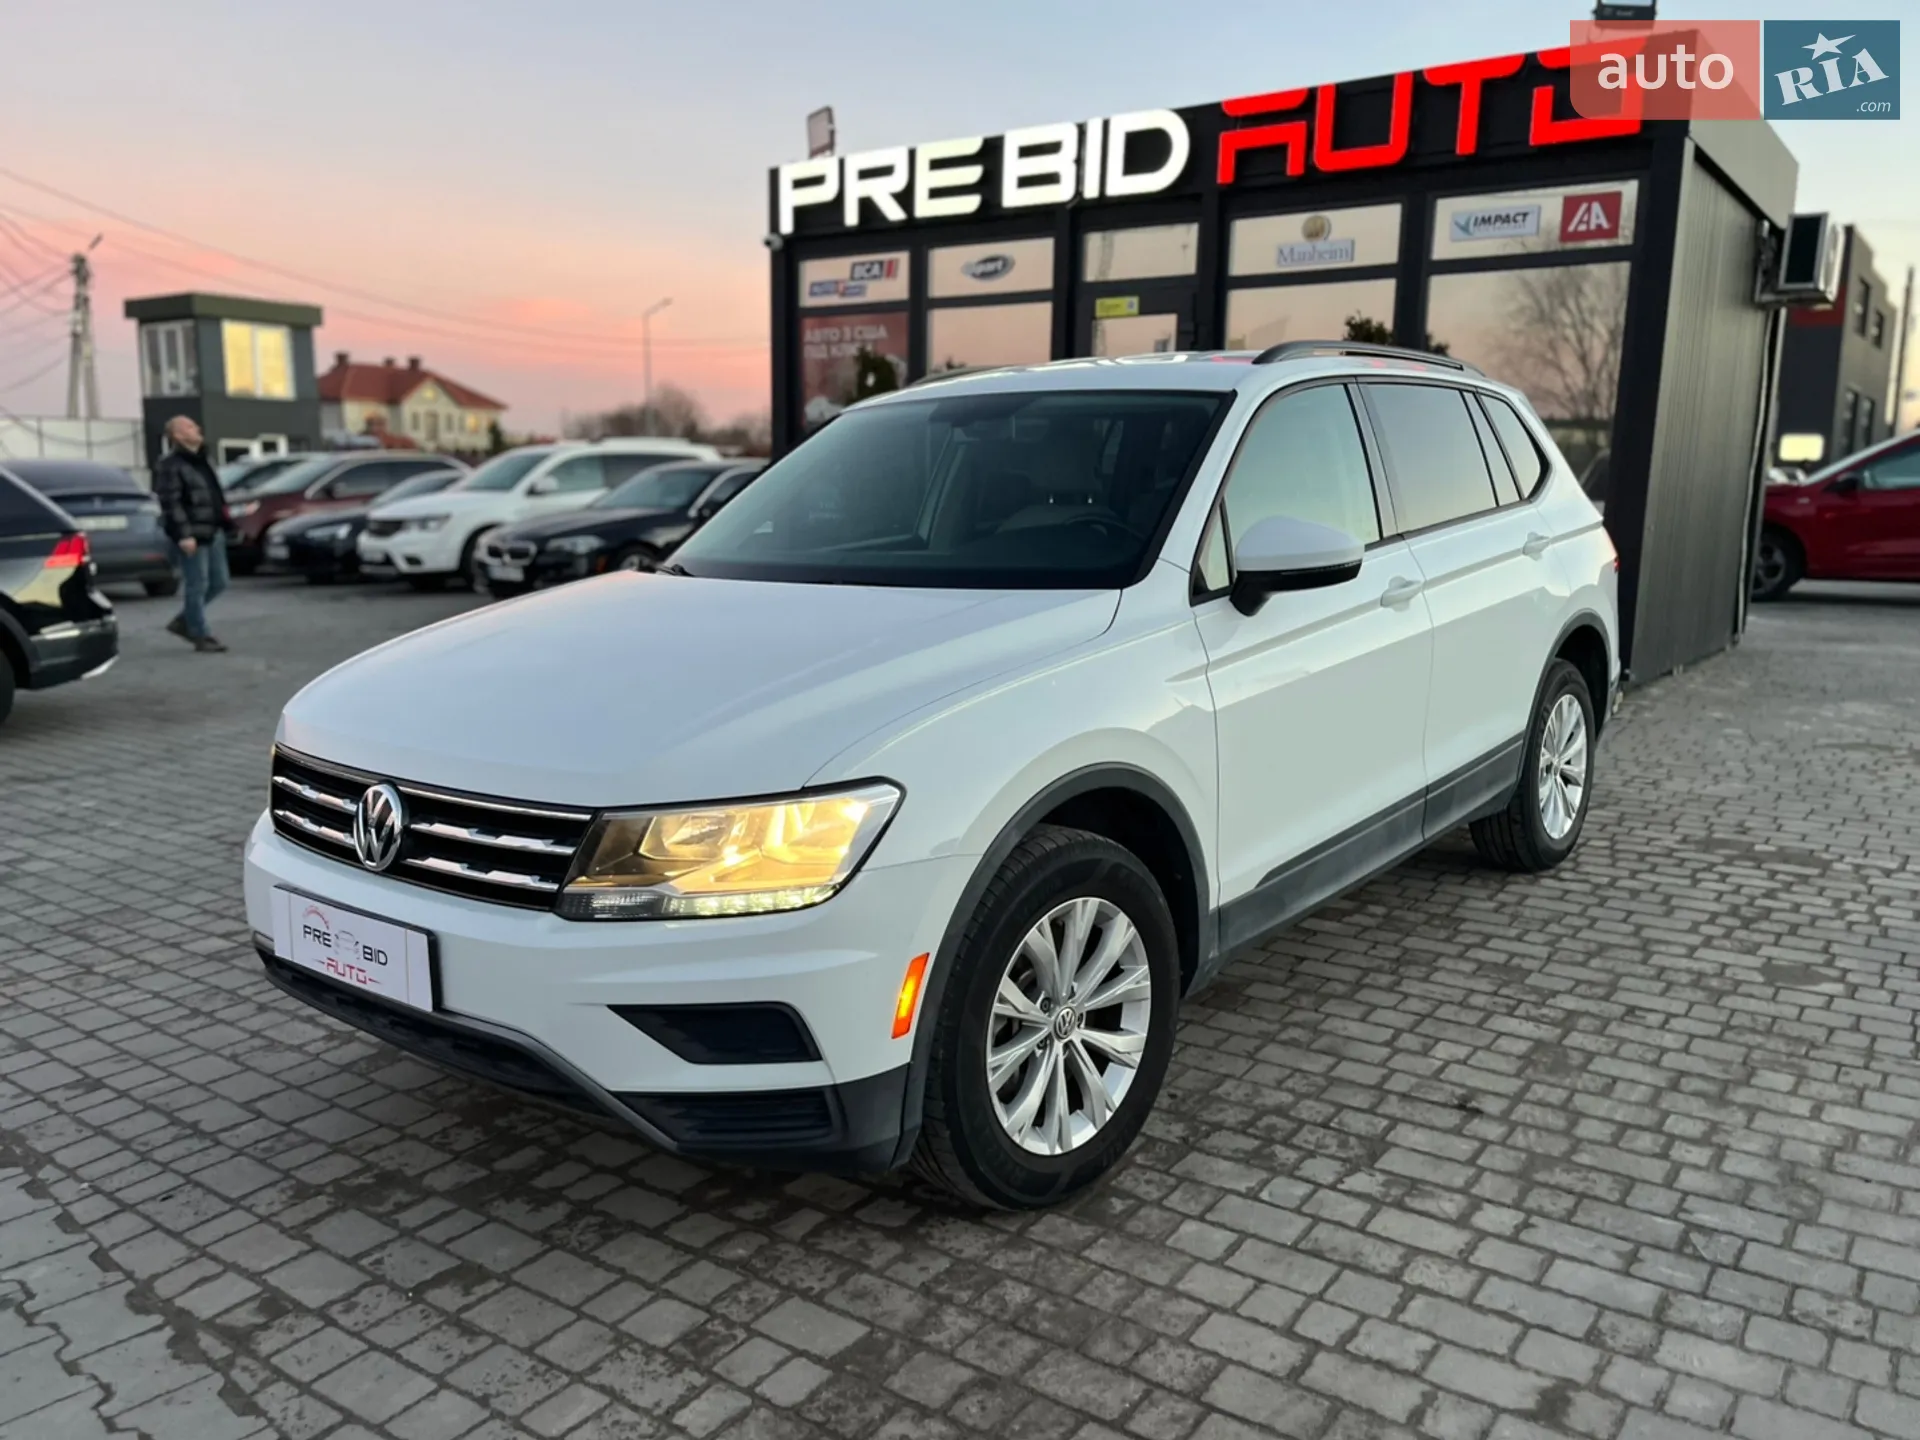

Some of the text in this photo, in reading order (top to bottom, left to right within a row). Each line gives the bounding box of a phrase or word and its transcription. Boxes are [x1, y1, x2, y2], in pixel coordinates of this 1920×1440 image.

[778, 36, 1648, 236] PRE BID AUTO
[1473, 211, 1531, 228] IMPACT
[1279, 243, 1350, 264] Manheim
[303, 924, 388, 966] PRE BID
[326, 956, 367, 985] AUTO
